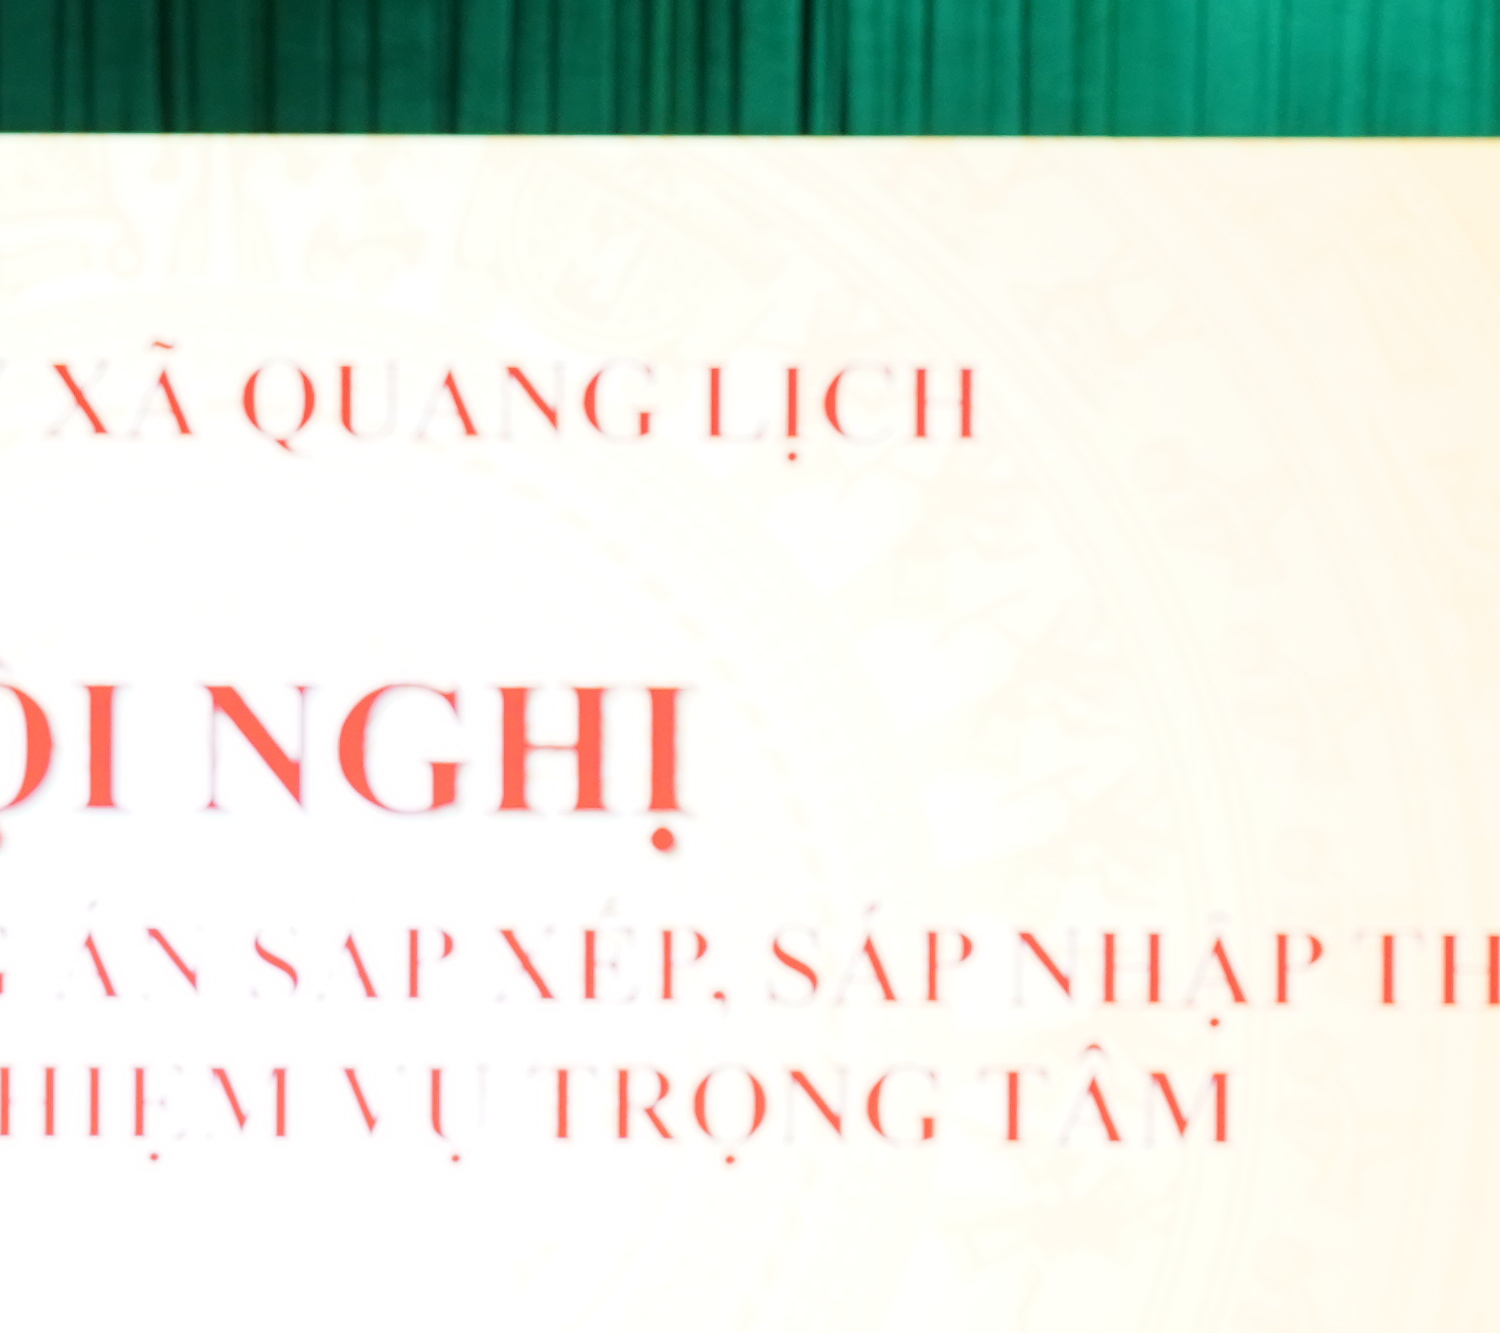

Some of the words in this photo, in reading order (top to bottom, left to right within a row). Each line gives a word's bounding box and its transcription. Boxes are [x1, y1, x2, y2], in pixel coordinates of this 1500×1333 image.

[43, 335, 199, 440] XÃ
[236, 356, 659, 459] QUANG
[703, 360, 981, 467] LỊCH
[194, 678, 699, 859] NGHỊ
[1011, 910, 1329, 1031] NHẬP
[338, 1062, 490, 1166] VỤ
[527, 1061, 941, 1169] TRỌNG
[976, 1038, 1235, 1148] TÂM
